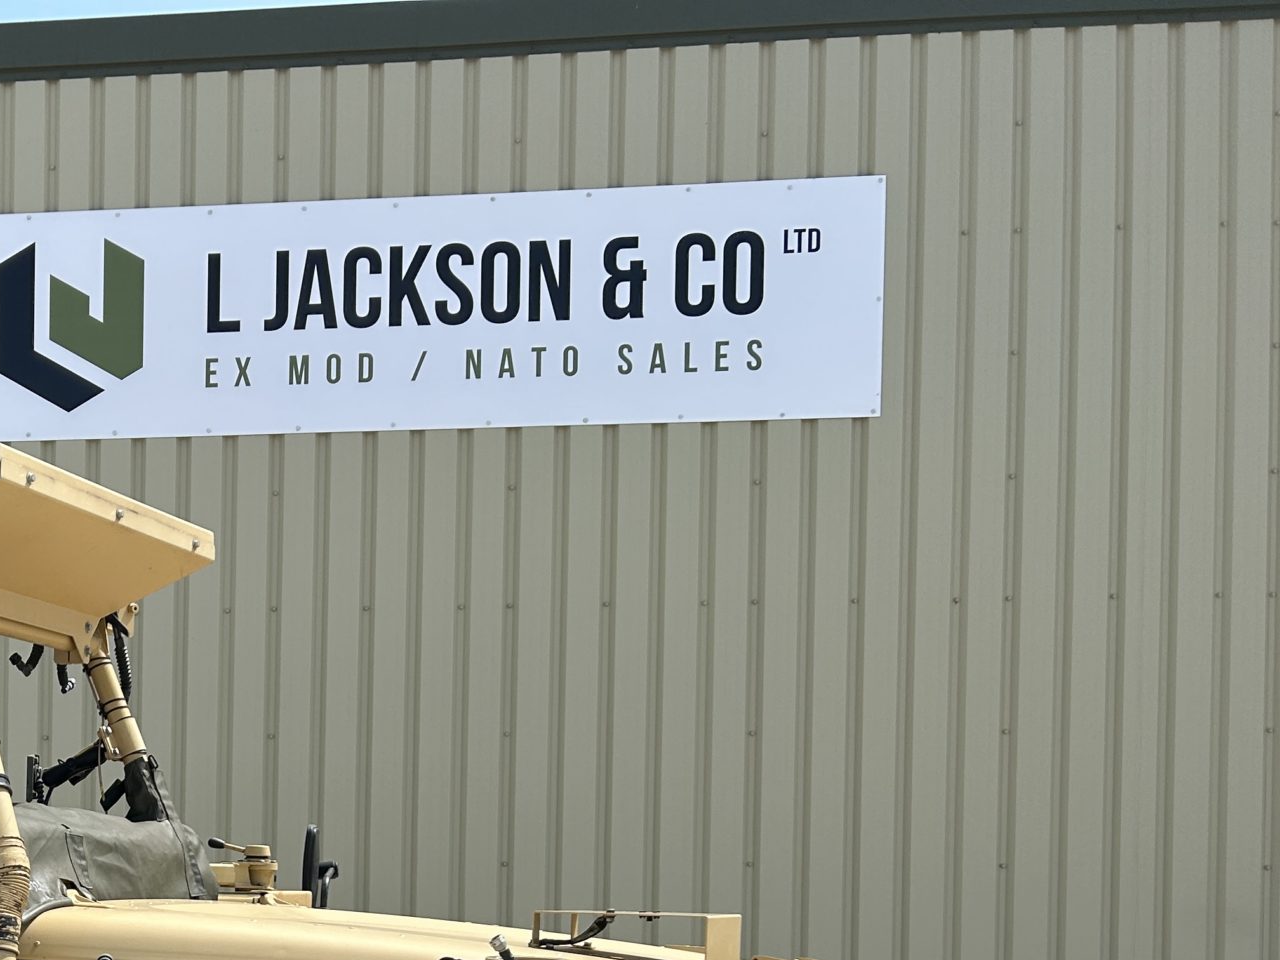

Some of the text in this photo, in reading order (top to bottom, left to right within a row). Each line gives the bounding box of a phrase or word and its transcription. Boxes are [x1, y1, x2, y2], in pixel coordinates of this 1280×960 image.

[206, 227, 821, 334] L JACKSON & CO LTD
[204, 339, 763, 389] EX MOD / NATO SALES
